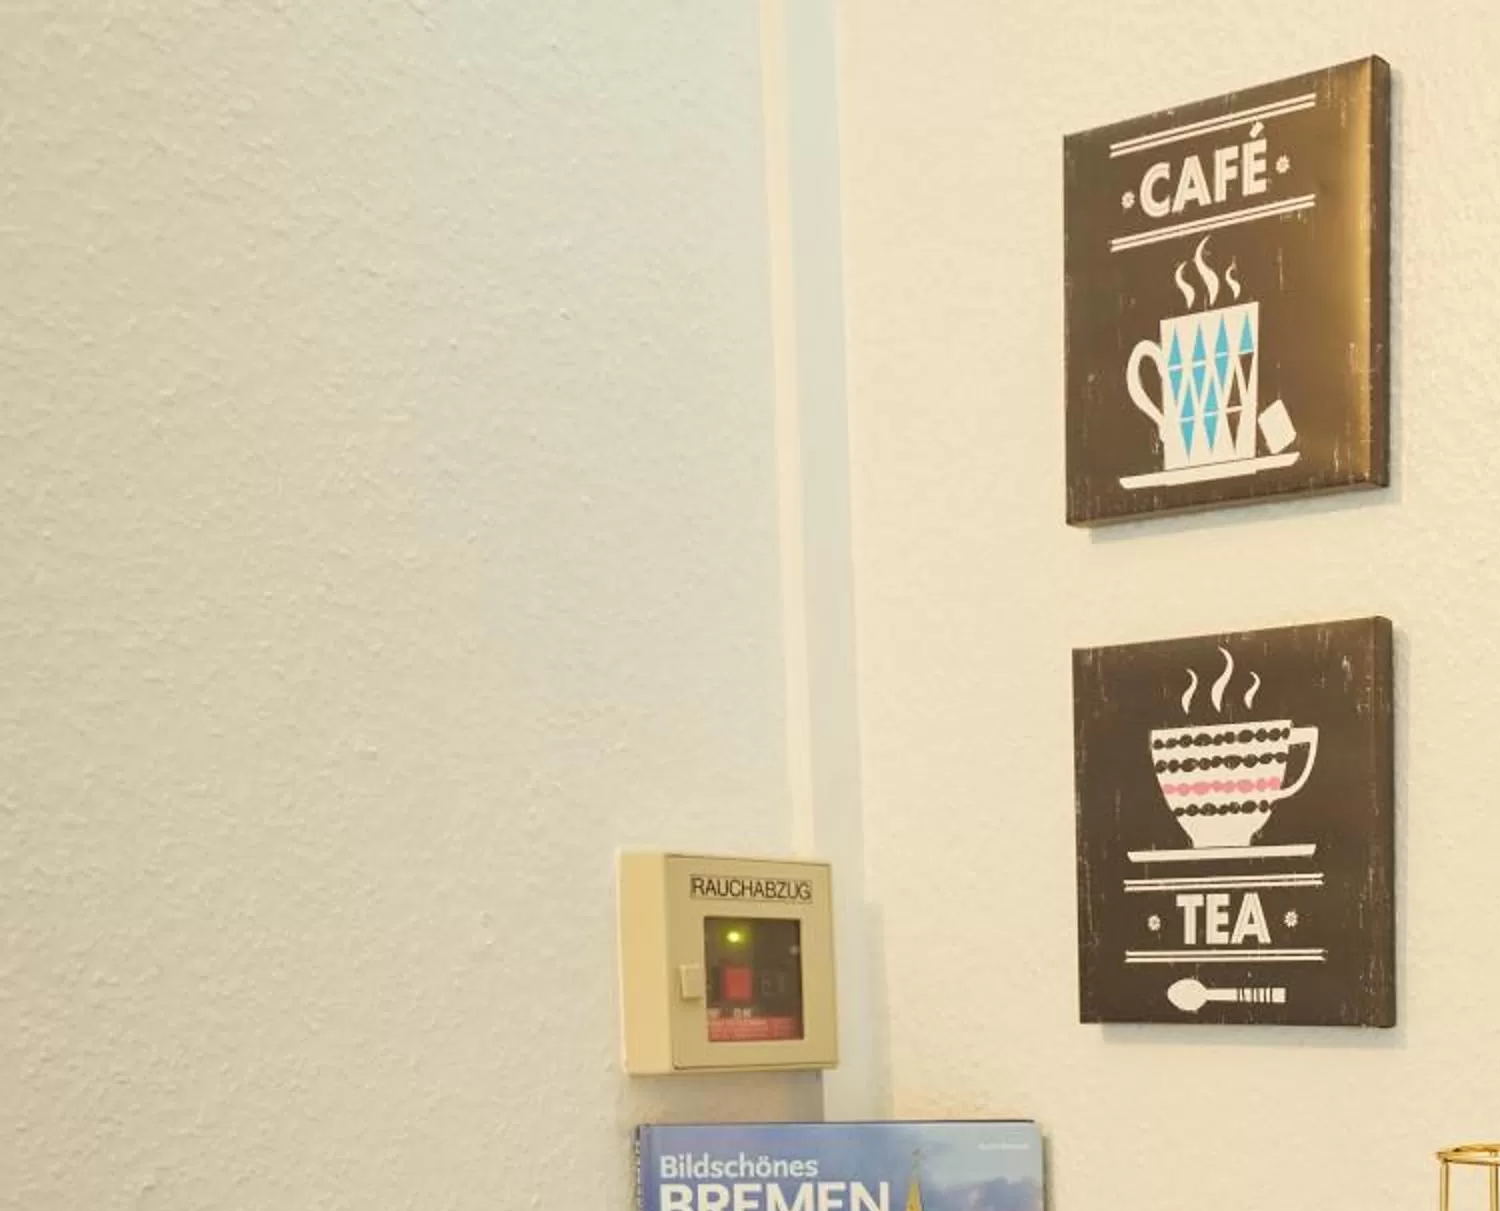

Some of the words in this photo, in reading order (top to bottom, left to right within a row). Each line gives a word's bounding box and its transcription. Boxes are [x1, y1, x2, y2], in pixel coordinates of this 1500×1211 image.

[1139, 121, 1268, 218] CAFÉ
[691, 877, 813, 900] RAUCHABZUG
[1176, 892, 1272, 945] TEA
[659, 1152, 819, 1179] Bildschönes
